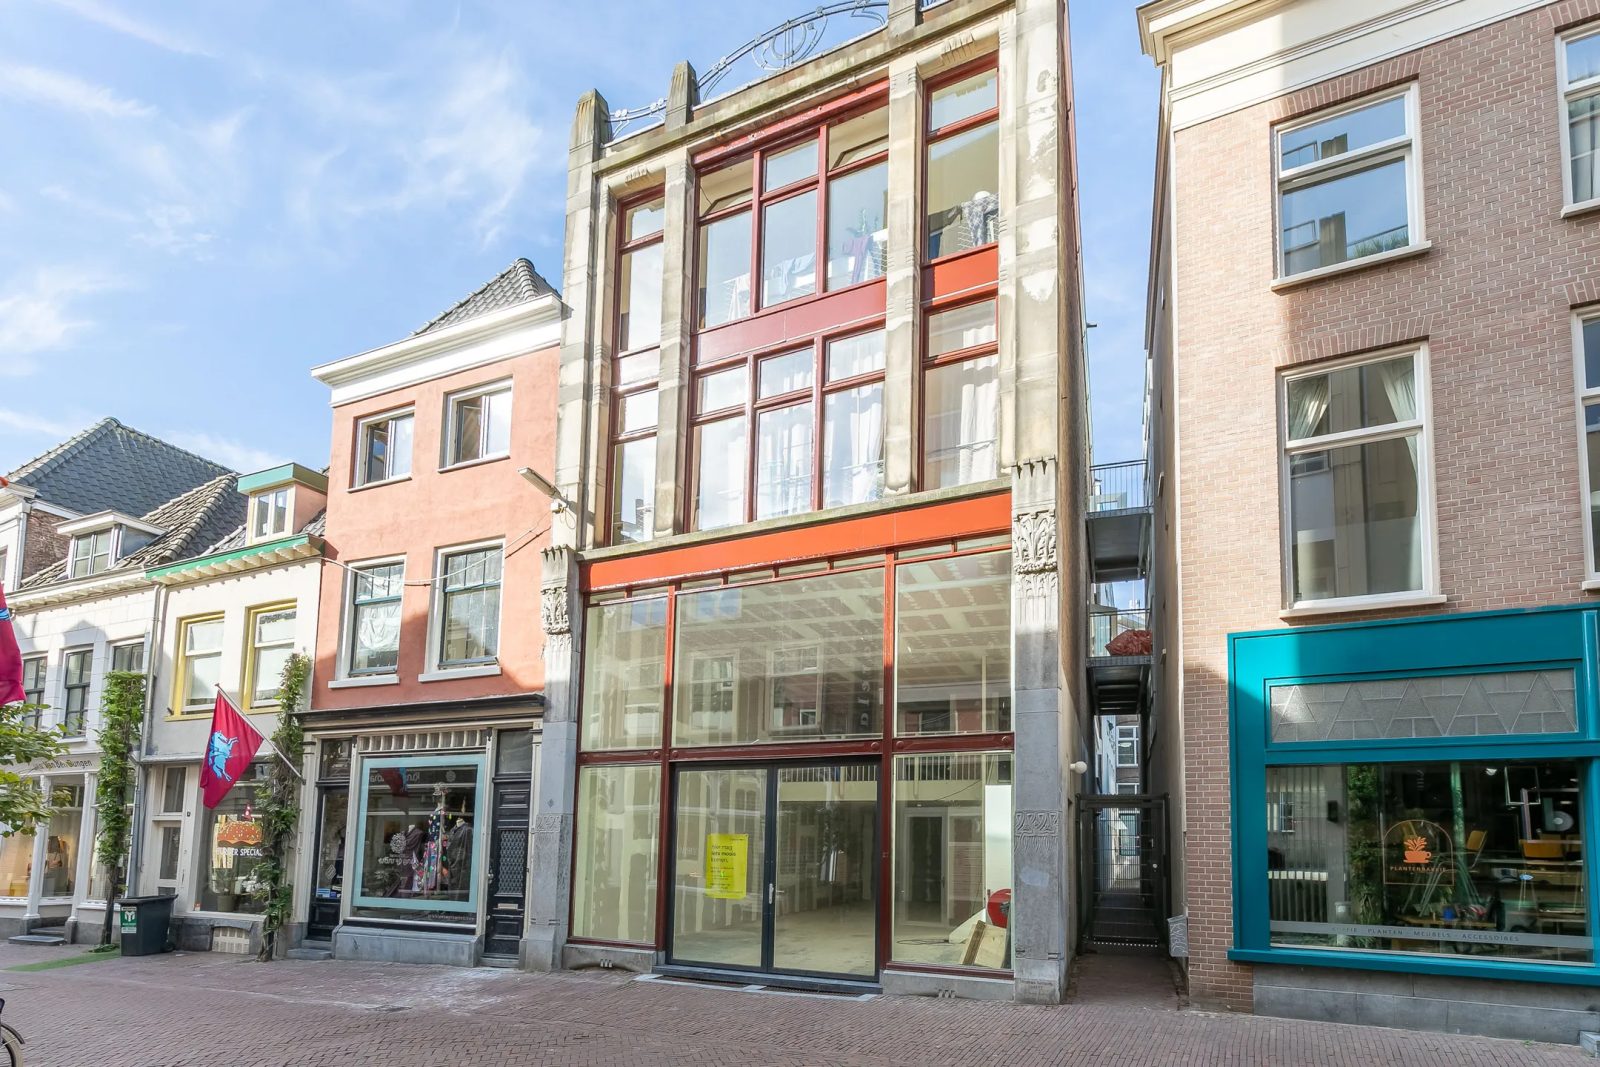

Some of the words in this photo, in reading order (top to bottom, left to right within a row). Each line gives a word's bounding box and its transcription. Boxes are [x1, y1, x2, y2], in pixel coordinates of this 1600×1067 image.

[1367, 928, 1403, 936] PLANTEN
[1413, 930, 1450, 938] MEUBELS
[1462, 933, 1520, 942] ACCESSOIRES
